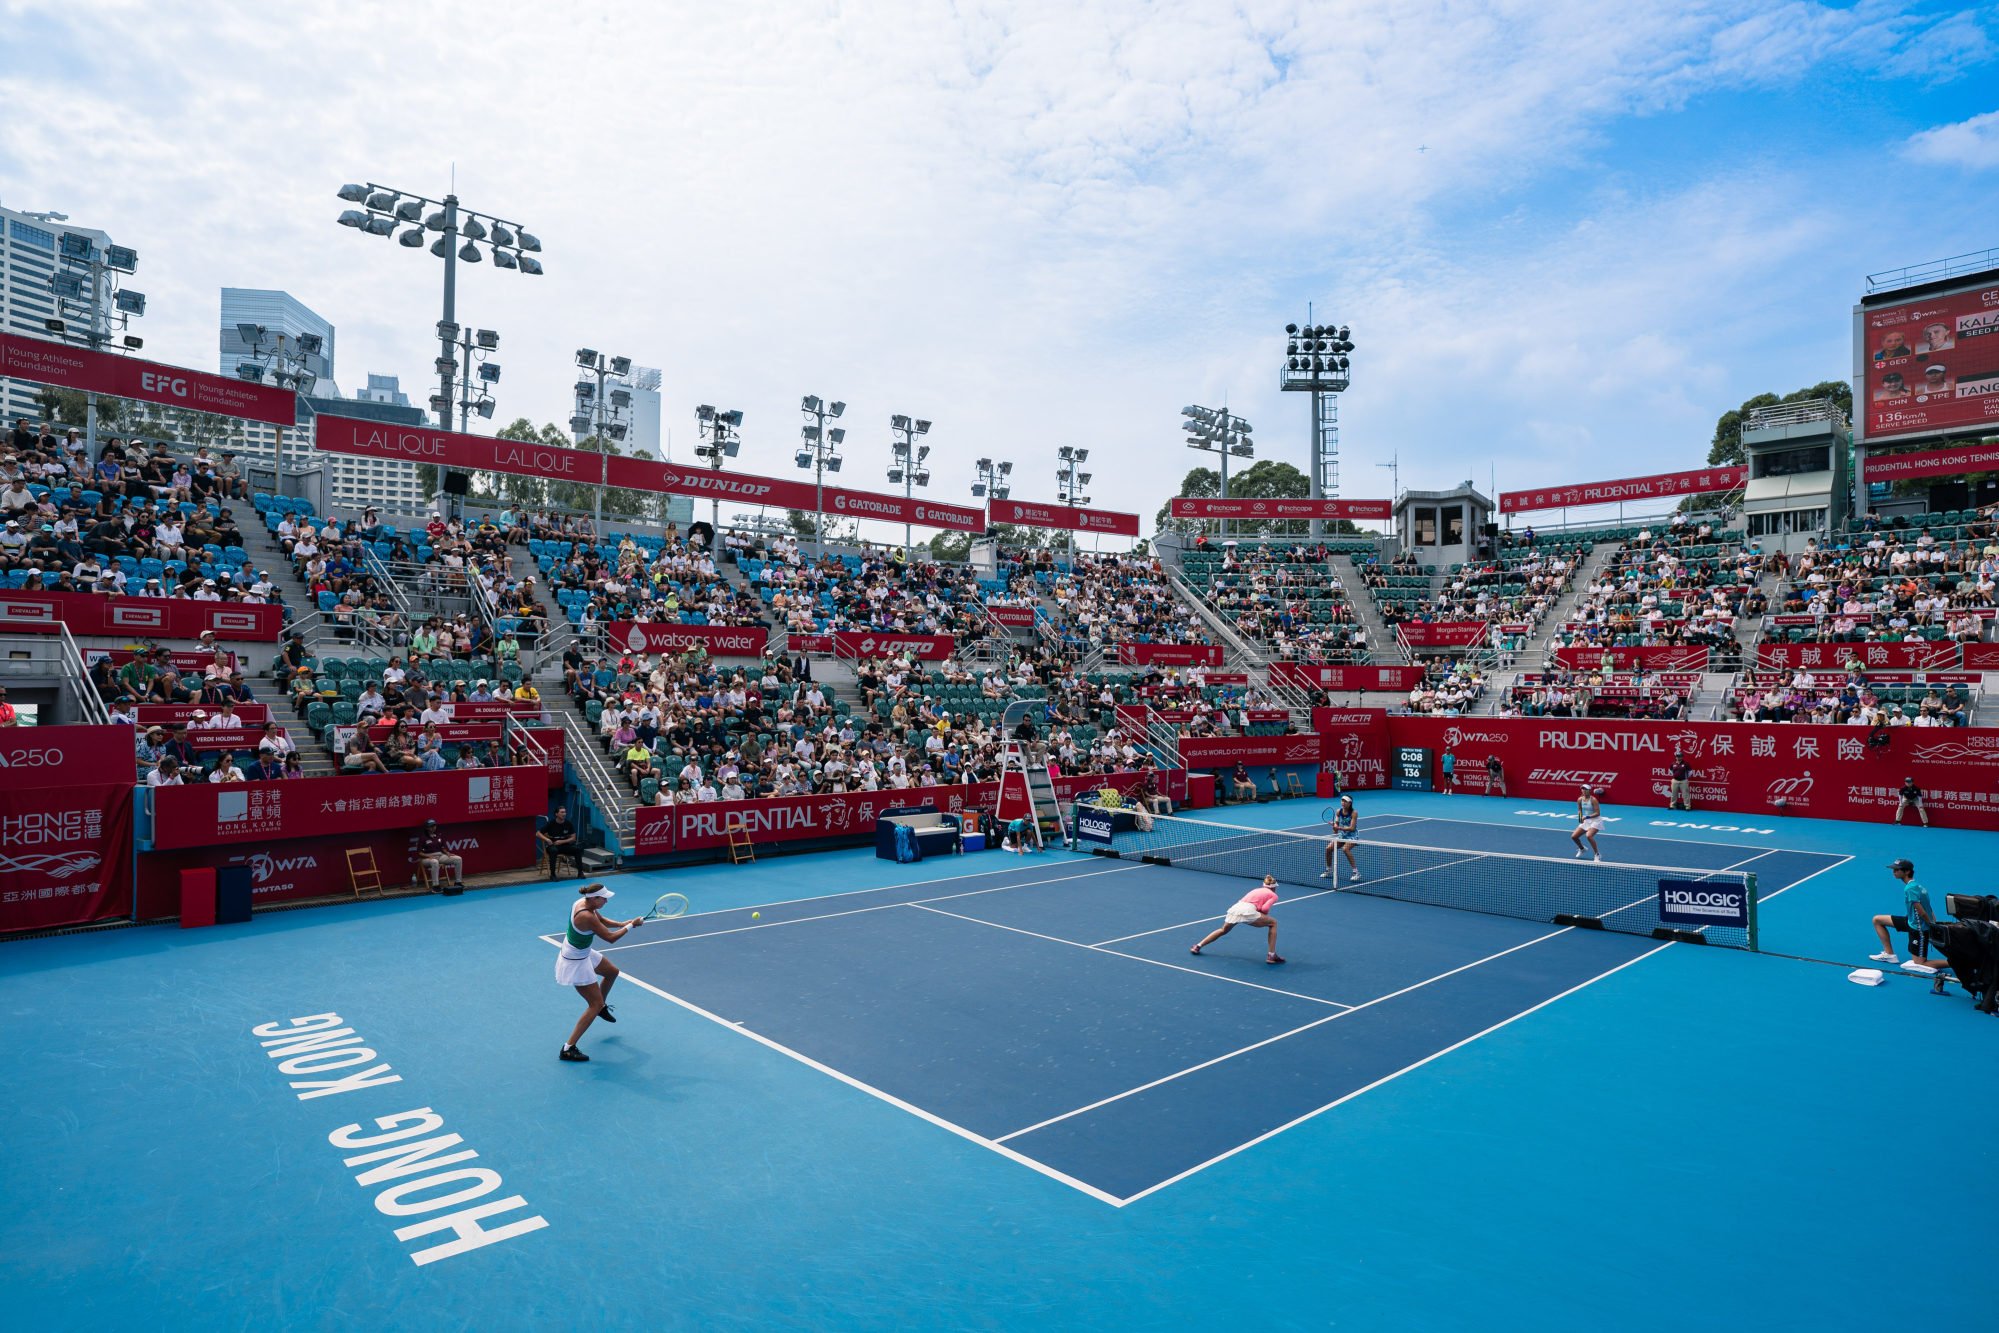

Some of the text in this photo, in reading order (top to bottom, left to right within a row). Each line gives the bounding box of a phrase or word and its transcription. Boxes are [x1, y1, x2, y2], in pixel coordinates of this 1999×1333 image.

[1966, 327, 1992, 336] SEED
[8, 346, 84, 368] Young Athletes
[8, 356, 68, 376] Foundation
[141, 371, 188, 398] EFG
[198, 382, 258, 402] Young Athletes
[198, 392, 245, 408] Foundation
[1876, 418, 1928, 430] SERVE SPEED
[353, 427, 446, 456] LALIQUE
[494, 446, 575, 474] LALIQUE
[1865, 452, 1999, 473] PRUDENTIAL HONG KONG TENNIS
[681, 474, 772, 496] DUNLOP
[1584, 482, 1654, 500] PRUDENTIAL
[849, 498, 901, 515] GATORADE
[928, 510, 974, 526] GATORADE
[998, 612, 1033, 622] GATORADE
[1436, 626, 1458, 634] Morgan
[650, 632, 710, 648] watsons
[714, 635, 754, 649] water
[879, 641, 934, 653] LOTTO
[1770, 646, 1890, 666] 保誠保險
[1337, 714, 1372, 722] HKCTA
[1463, 733, 1508, 743] WTA250
[1540, 731, 1866, 761] PRUDENTIAL 保誠保險
[1401, 753, 1423, 761] 0:08
[1454, 759, 1486, 768] DENTIAL
[1323, 759, 1385, 773] PRUDENTIAL
[1404, 768, 1420, 777] 136
[491, 775, 514, 788] 香港
[1541, 769, 1619, 783] HKCTA
[250, 789, 281, 805] 香港
[1878, 798, 1900, 806] Spor
[3, 811, 81, 830] HONG
[250, 805, 281, 820] 寬頻
[682, 806, 817, 839] PRUDENTIAL
[1080, 818, 1111, 831] HOLOGIC
[1650, 820, 1775, 835] HONG
[3, 826, 81, 846] KONG
[275, 856, 317, 872] WTA
[3, 883, 102, 902] 亞洲國際都會
[1664, 890, 1740, 907] HOLOGIC
[252, 1012, 403, 1100] KONG
[328, 1106, 550, 1267] HONG
